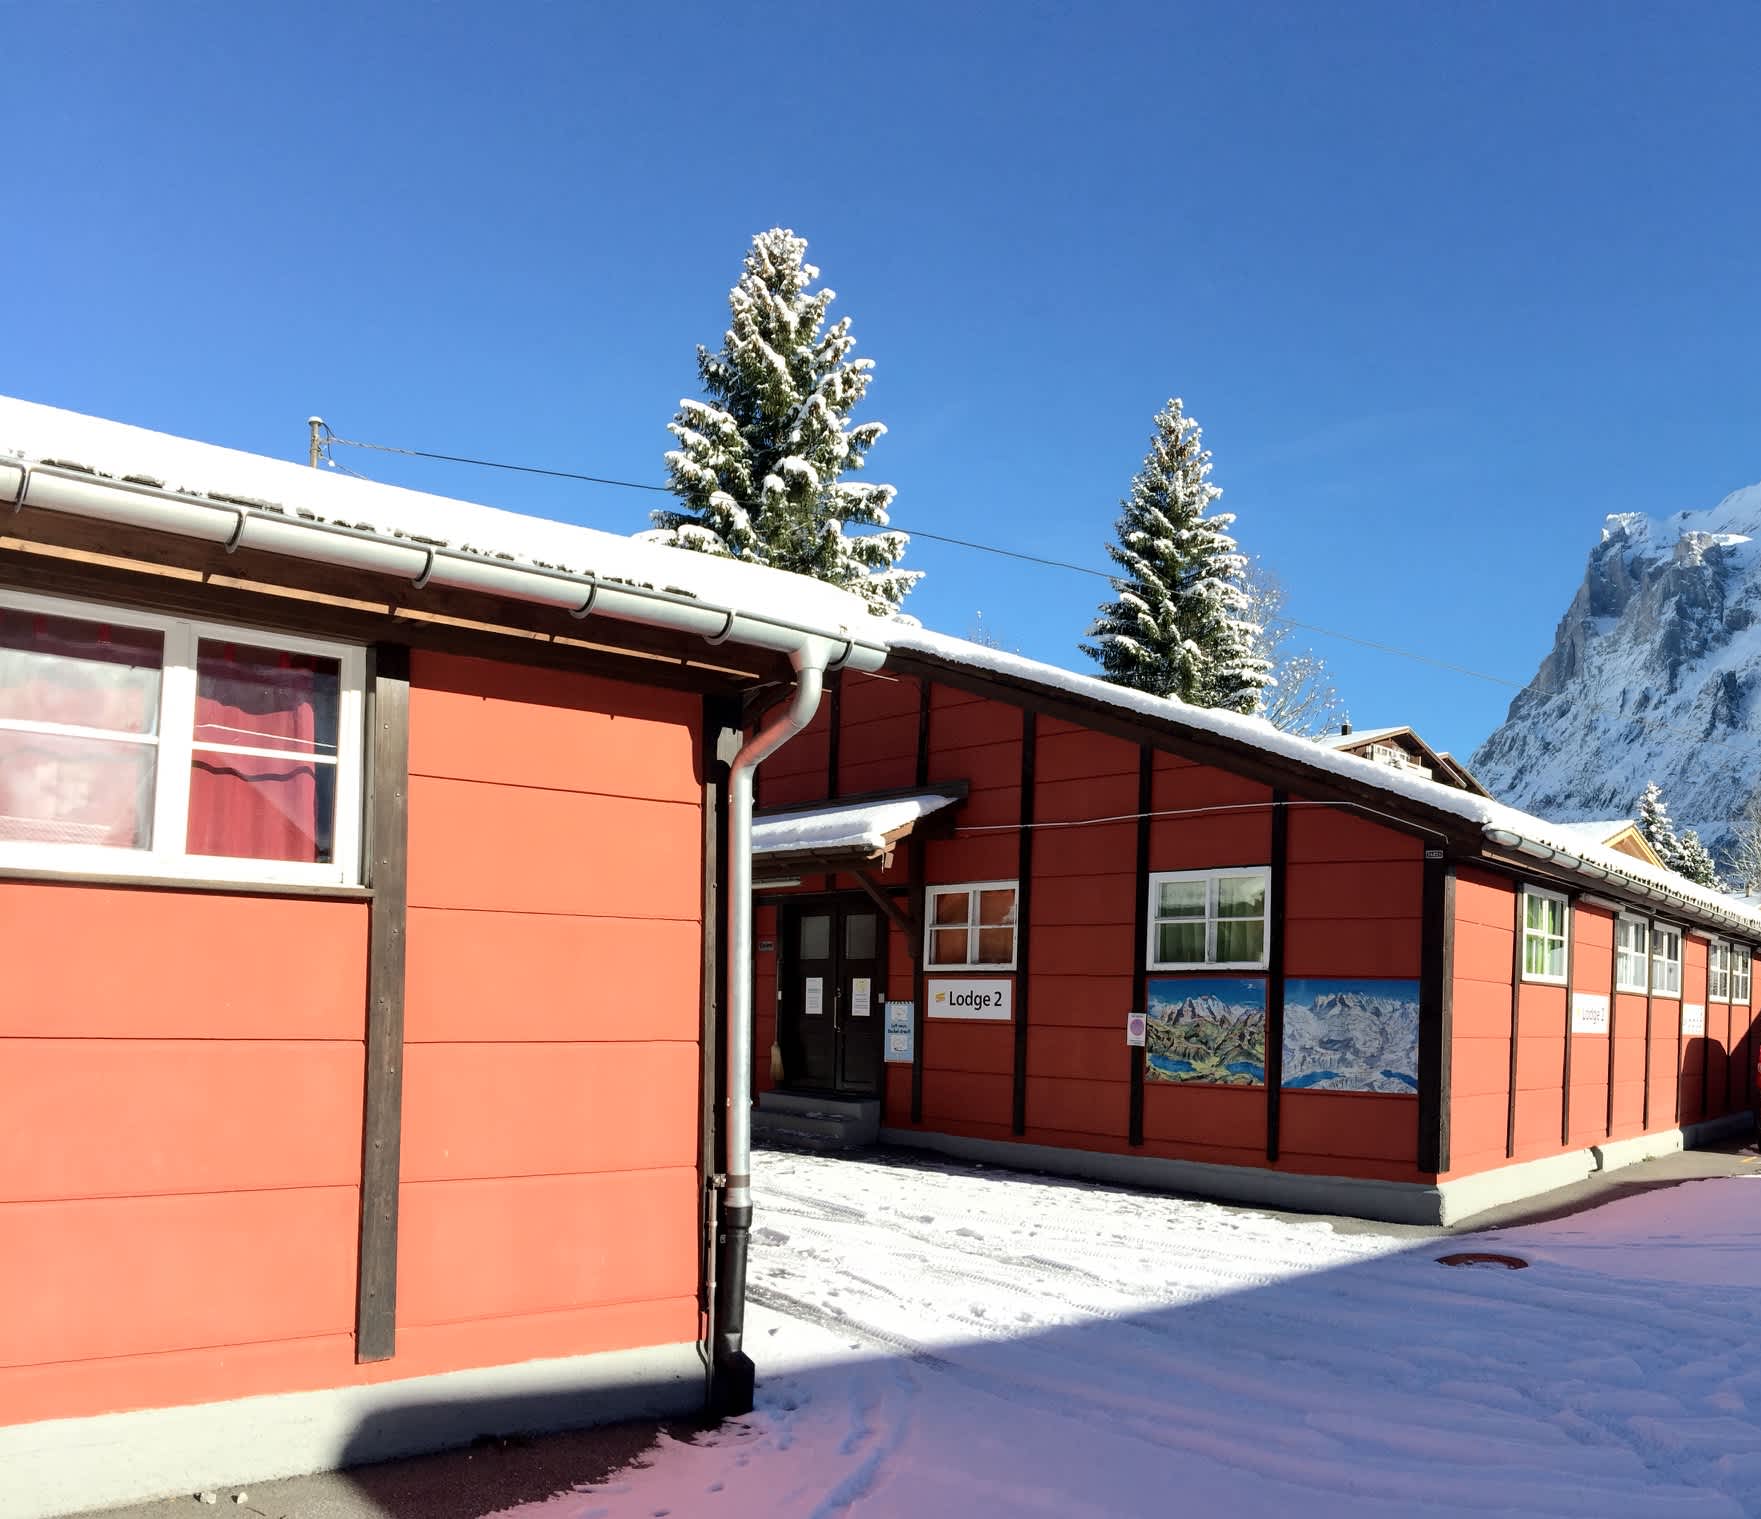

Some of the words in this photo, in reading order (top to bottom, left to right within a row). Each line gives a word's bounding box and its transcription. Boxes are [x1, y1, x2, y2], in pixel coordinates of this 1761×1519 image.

[949, 990, 991, 1011] Lodge
[994, 991, 1002, 1007] 2
[1582, 1007, 1600, 1025] Lodge
